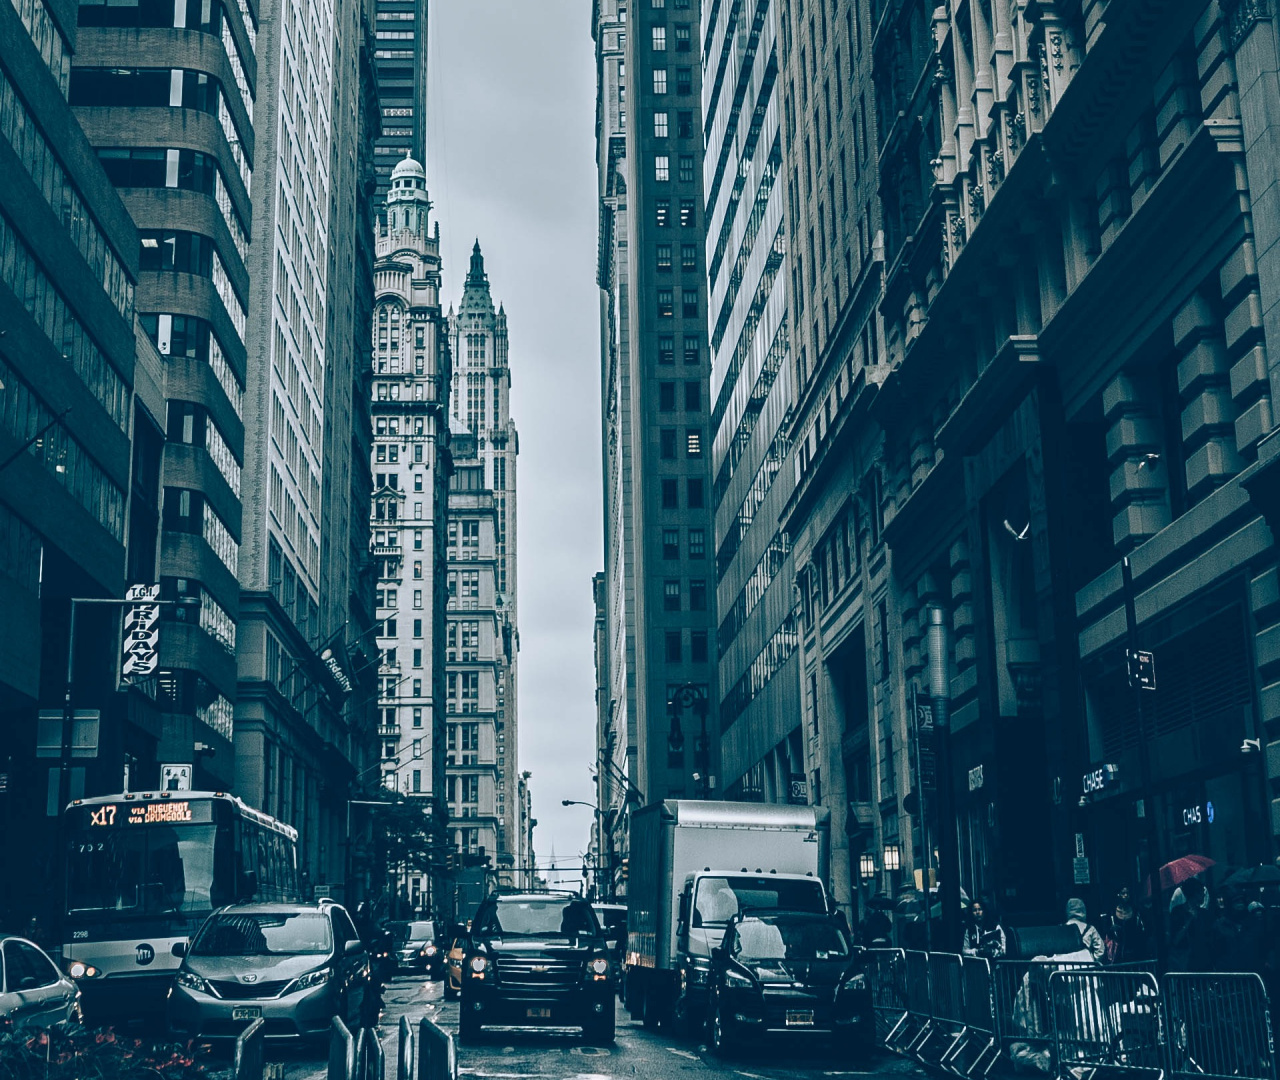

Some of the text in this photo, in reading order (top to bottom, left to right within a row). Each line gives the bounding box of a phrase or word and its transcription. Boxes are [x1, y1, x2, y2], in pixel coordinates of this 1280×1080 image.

[131, 587, 155, 597] T.G.I.
[326, 657, 353, 693] Fidelity
[1083, 769, 1104, 793] CHASE
[148, 801, 189, 814] HUGUENOT
[145, 810, 192, 824] DRUMGOOLE
